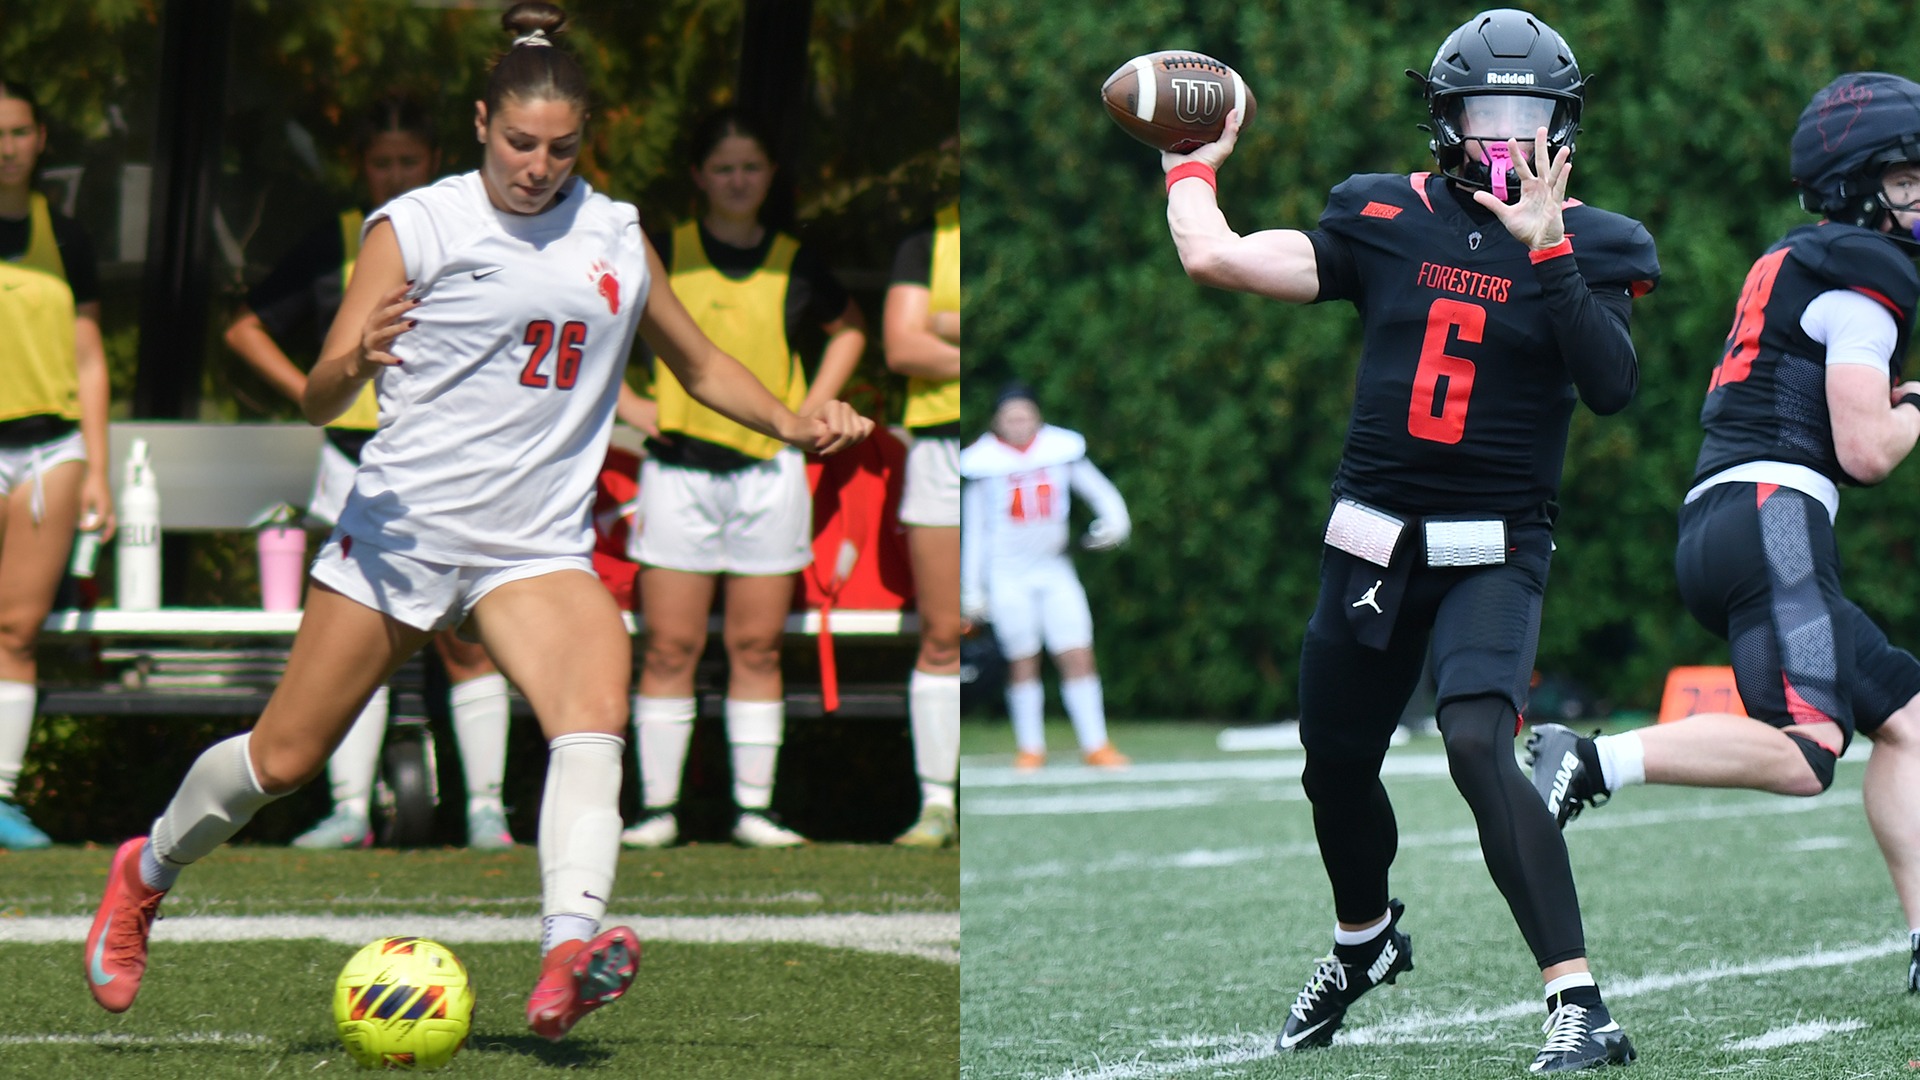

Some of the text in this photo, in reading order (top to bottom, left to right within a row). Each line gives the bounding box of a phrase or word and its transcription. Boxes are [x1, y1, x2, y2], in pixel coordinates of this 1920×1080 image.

[1487, 73, 1534, 85] Riddell
[1417, 261, 1513, 303] FORESTERS
[519, 319, 588, 391] 26
[1407, 297, 1487, 445] 6
[1366, 938, 1399, 985] NIKE
